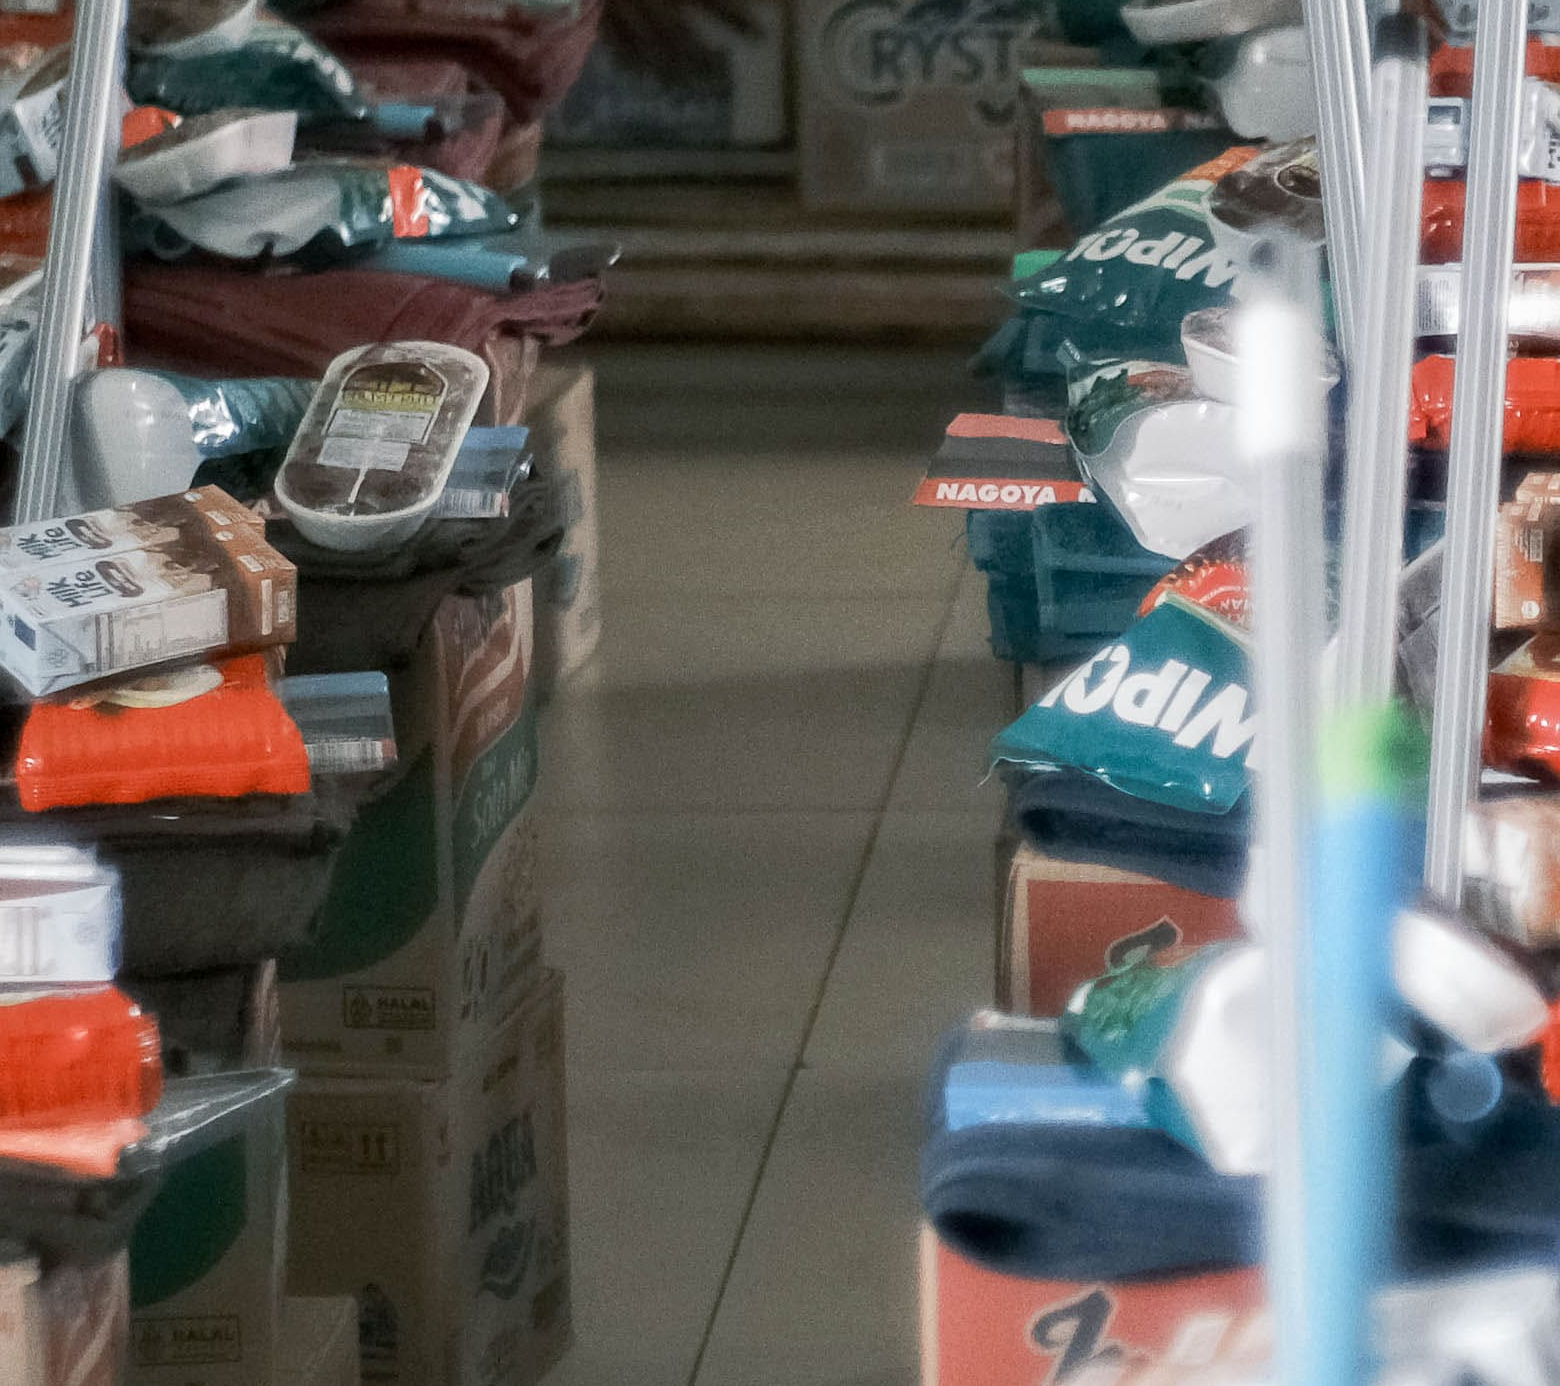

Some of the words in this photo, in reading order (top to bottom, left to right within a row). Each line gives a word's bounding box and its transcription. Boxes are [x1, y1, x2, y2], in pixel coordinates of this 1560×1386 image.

[936, 482, 1064, 505] NAGOYA
[16, 532, 56, 560] Milk
[42, 525, 83, 553] Life
[46, 575, 84, 608] Milk
[68, 568, 114, 605] Life
